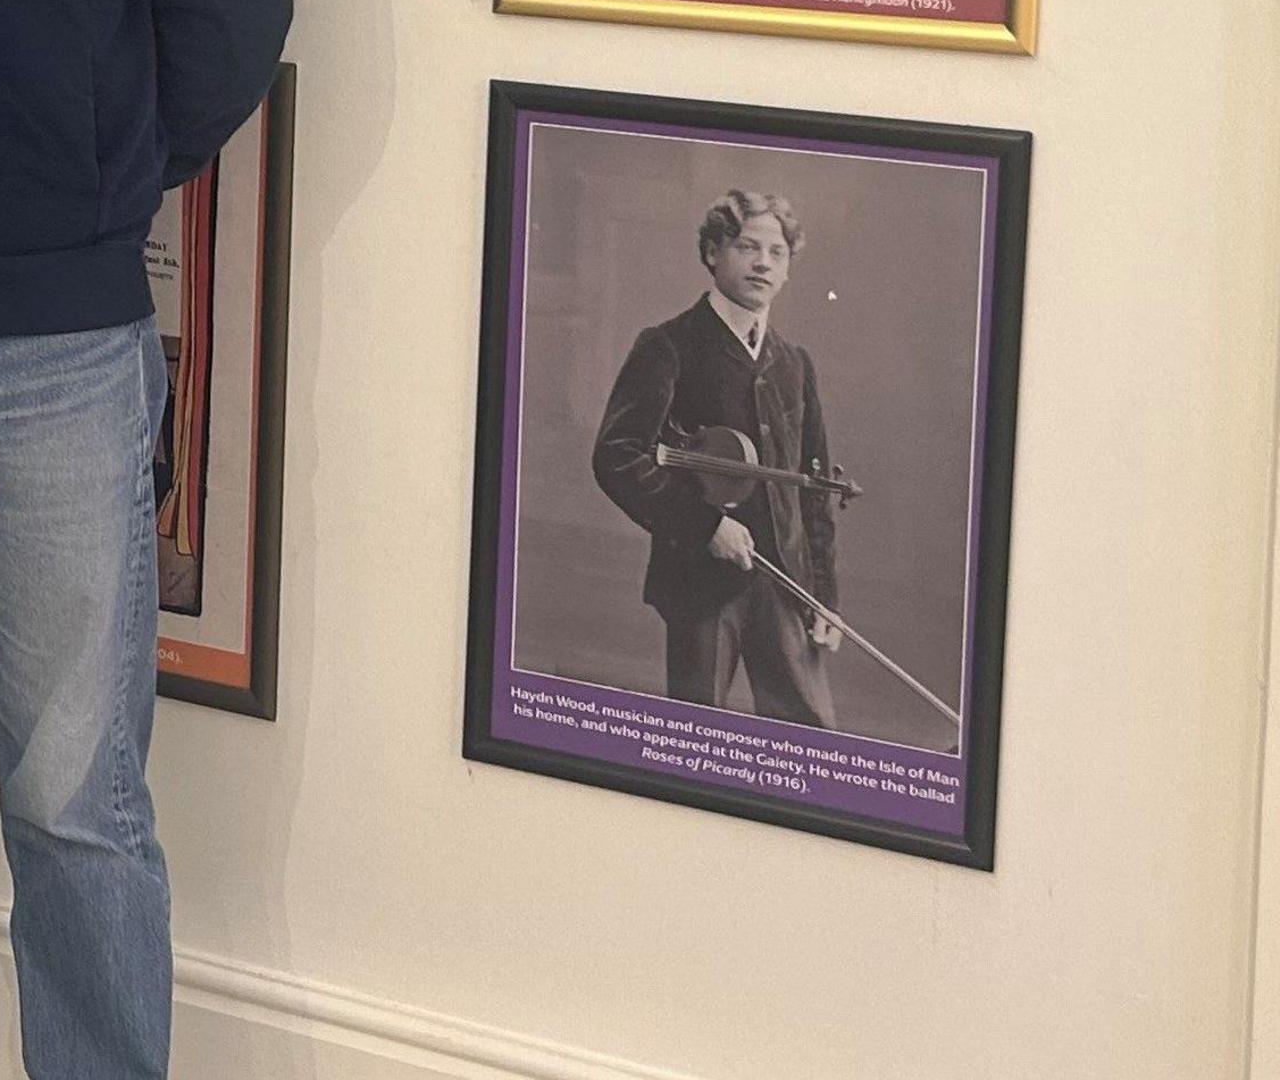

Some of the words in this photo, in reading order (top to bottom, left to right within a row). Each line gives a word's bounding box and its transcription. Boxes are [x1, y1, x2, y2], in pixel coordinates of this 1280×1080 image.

[510, 685, 554, 706] Haydn
[555, 694, 600, 715] Wood,
[601, 705, 664, 727] musician
[666, 717, 693, 733] and
[695, 724, 767, 748] composer
[770, 739, 804, 755] who
[806, 745, 848, 765] made
[851, 755, 878, 770] the
[879, 760, 906, 776] Isle
[908, 766, 924, 779] of
[926, 770, 960, 787] Man
[513, 702, 533, 718] his
[535, 707, 579, 728] home,
[581, 717, 607, 733] and
[609, 723, 640, 739] who
[642, 730, 710, 754] appeared
[711, 743, 727, 757] at
[728, 746, 754, 763] the
[808, 763, 830, 779] He
[832, 771, 878, 788] wrote
[880, 778, 907, 794] the
[909, 781, 955, 804] ballad
[642, 746, 683, 766] Roses
[685, 756, 703, 771] of
[703, 757, 756, 783] Picardy
[758, 770, 811, 793] (1916).
